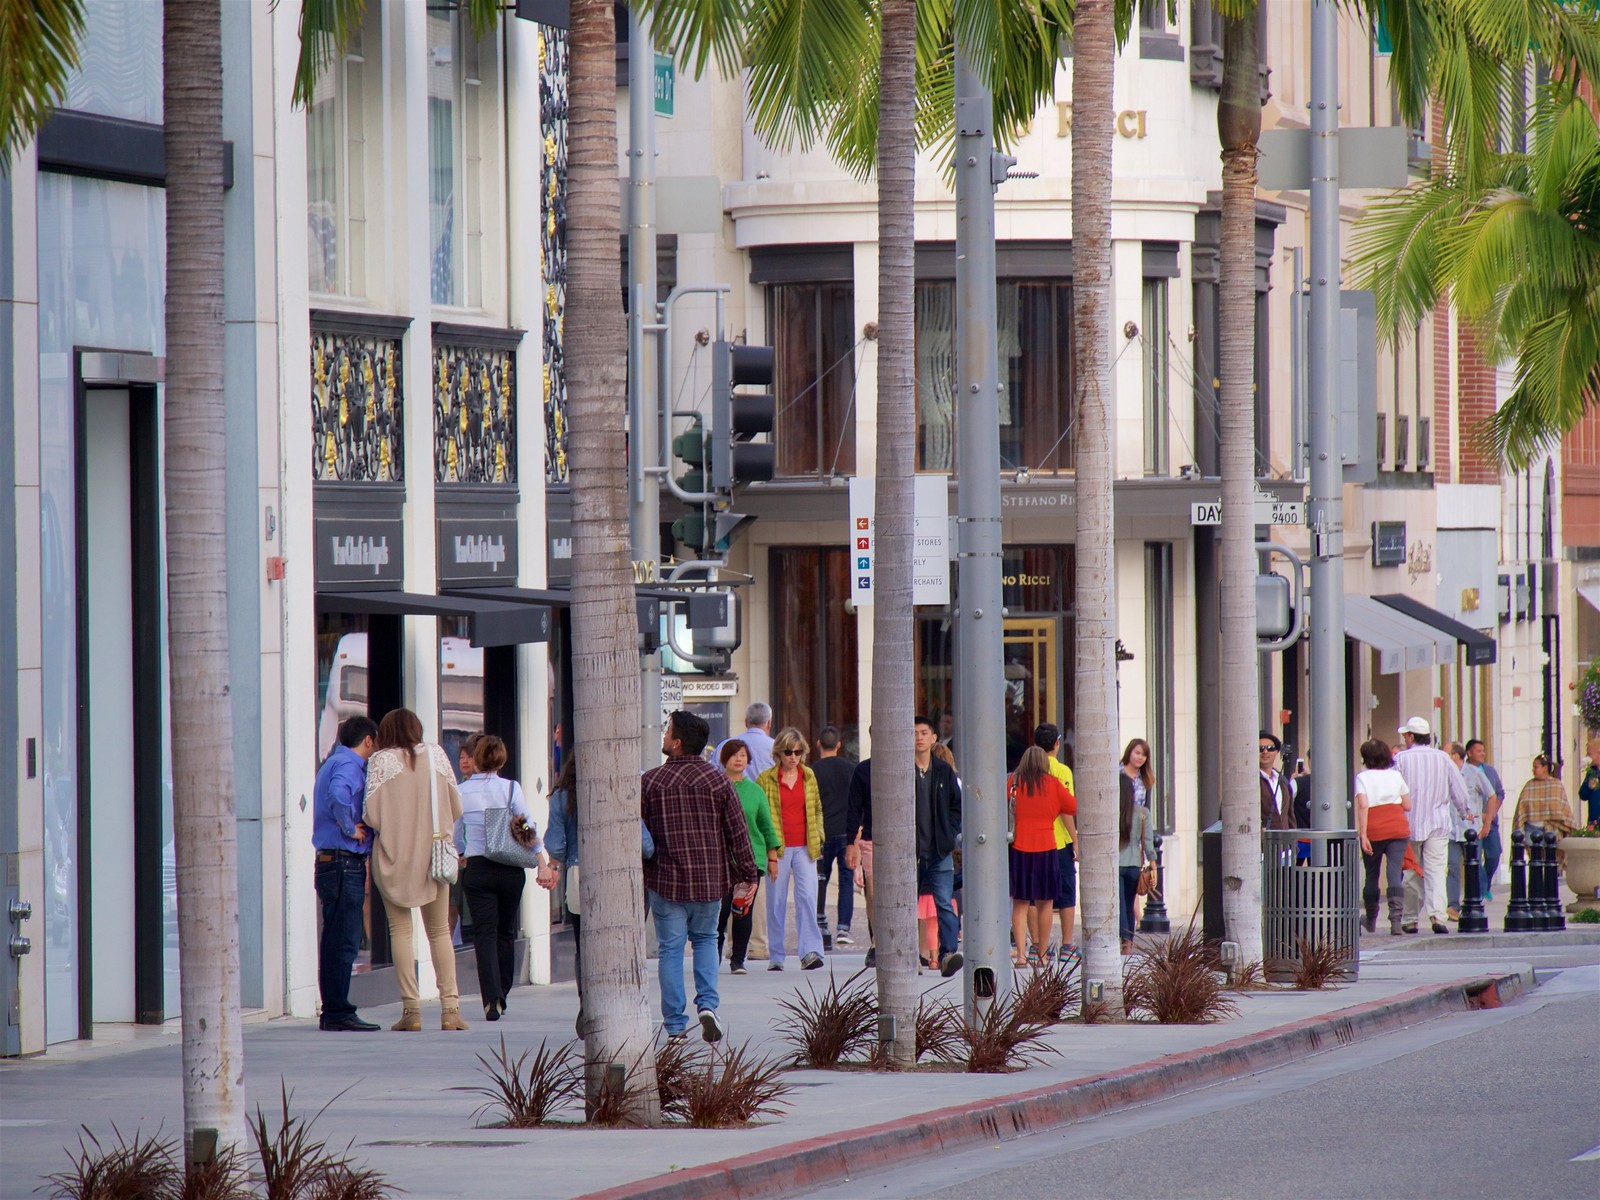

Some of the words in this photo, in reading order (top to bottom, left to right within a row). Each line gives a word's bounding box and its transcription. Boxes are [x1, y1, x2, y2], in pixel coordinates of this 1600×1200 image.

[1002, 495, 1056, 507] STEFANO
[1197, 505, 1222, 522] DAY
[1272, 503, 1284, 512] WY
[1272, 512, 1298, 524] 9400
[1019, 573, 1051, 586] RICCI
